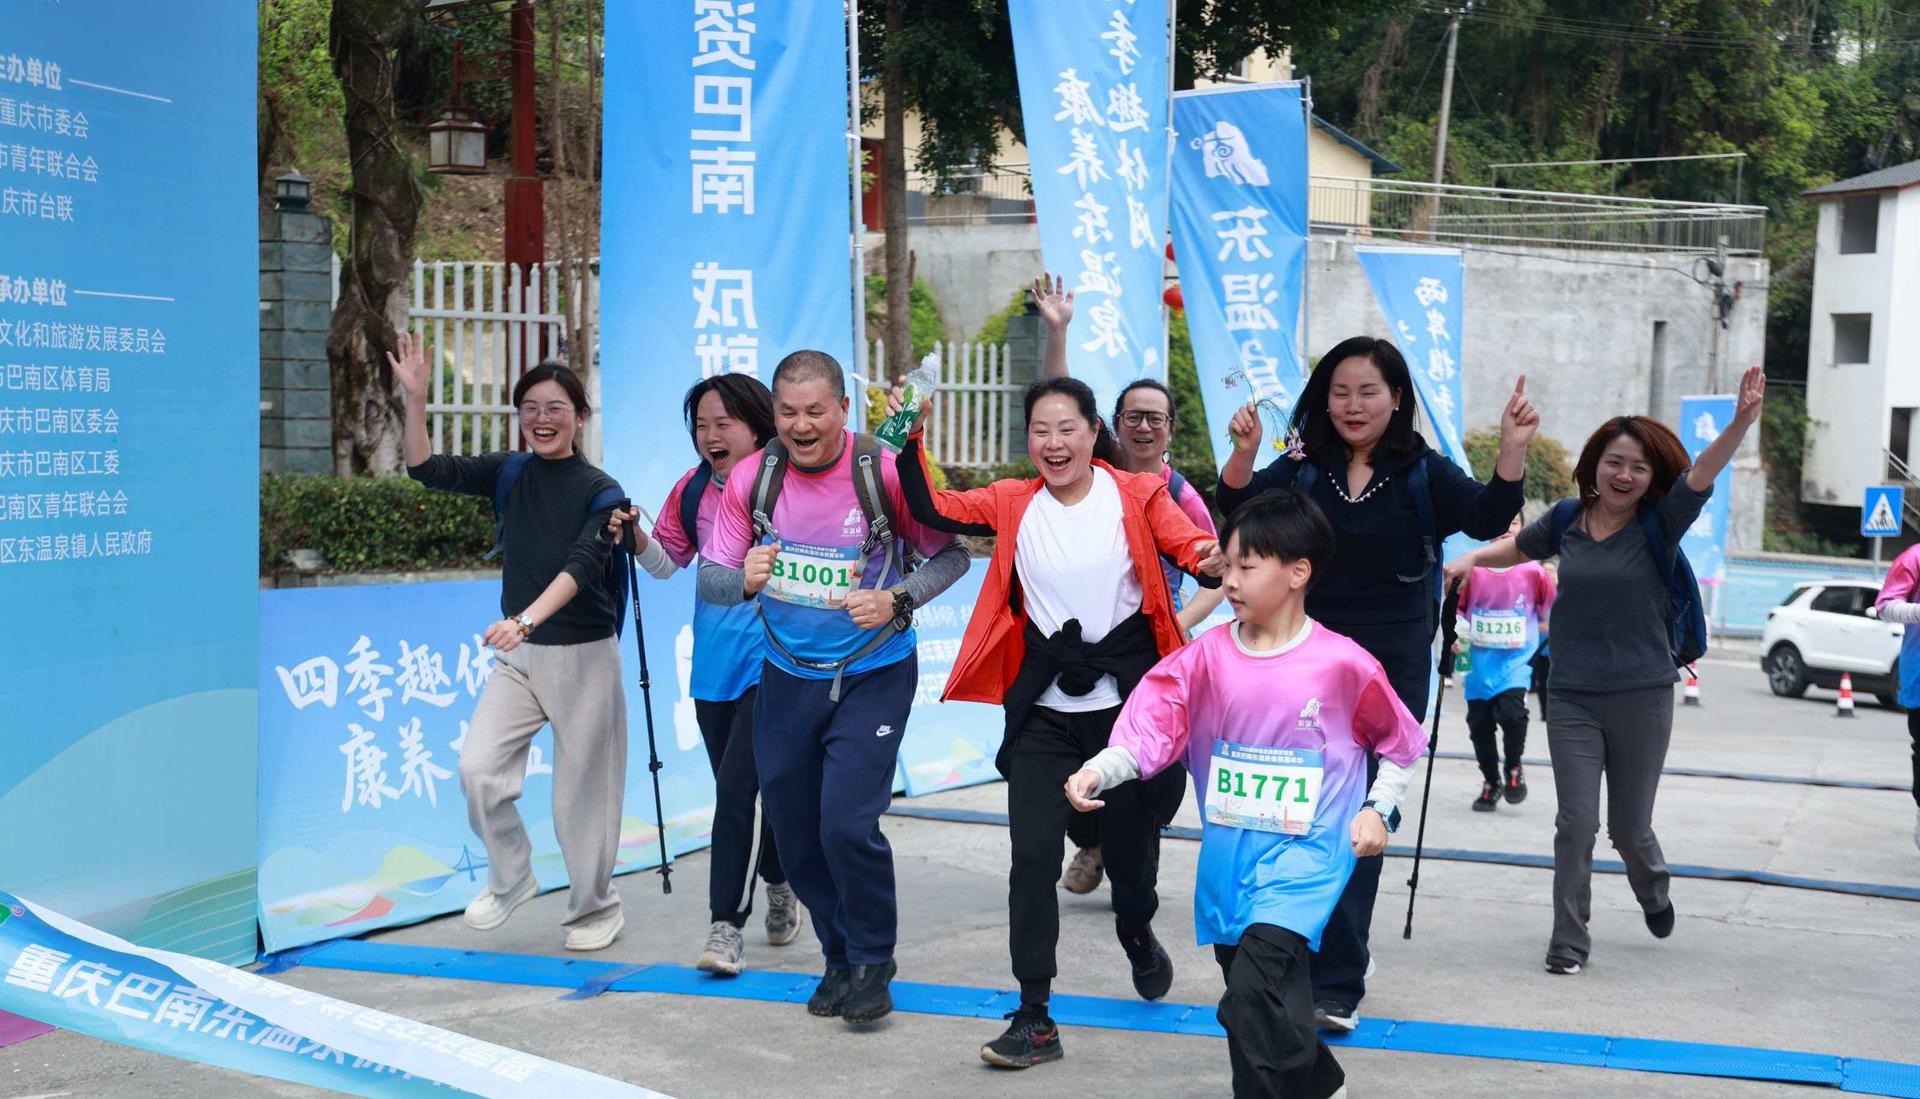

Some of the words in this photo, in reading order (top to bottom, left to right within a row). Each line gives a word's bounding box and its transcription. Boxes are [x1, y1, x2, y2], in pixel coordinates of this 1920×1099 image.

[0, 187, 74, 222] 庆市台联
[0, 319, 166, 354] 文化和旅游发展委员会
[0, 406, 119, 434] 庆市巴南区委会
[0, 449, 119, 477] 庆市巴南区工委
[0, 528, 152, 563] 区东温泉镇人民政府
[771, 558, 849, 587] B1001
[1476, 620, 1521, 634] B1216
[1217, 768, 1310, 803] B1771
